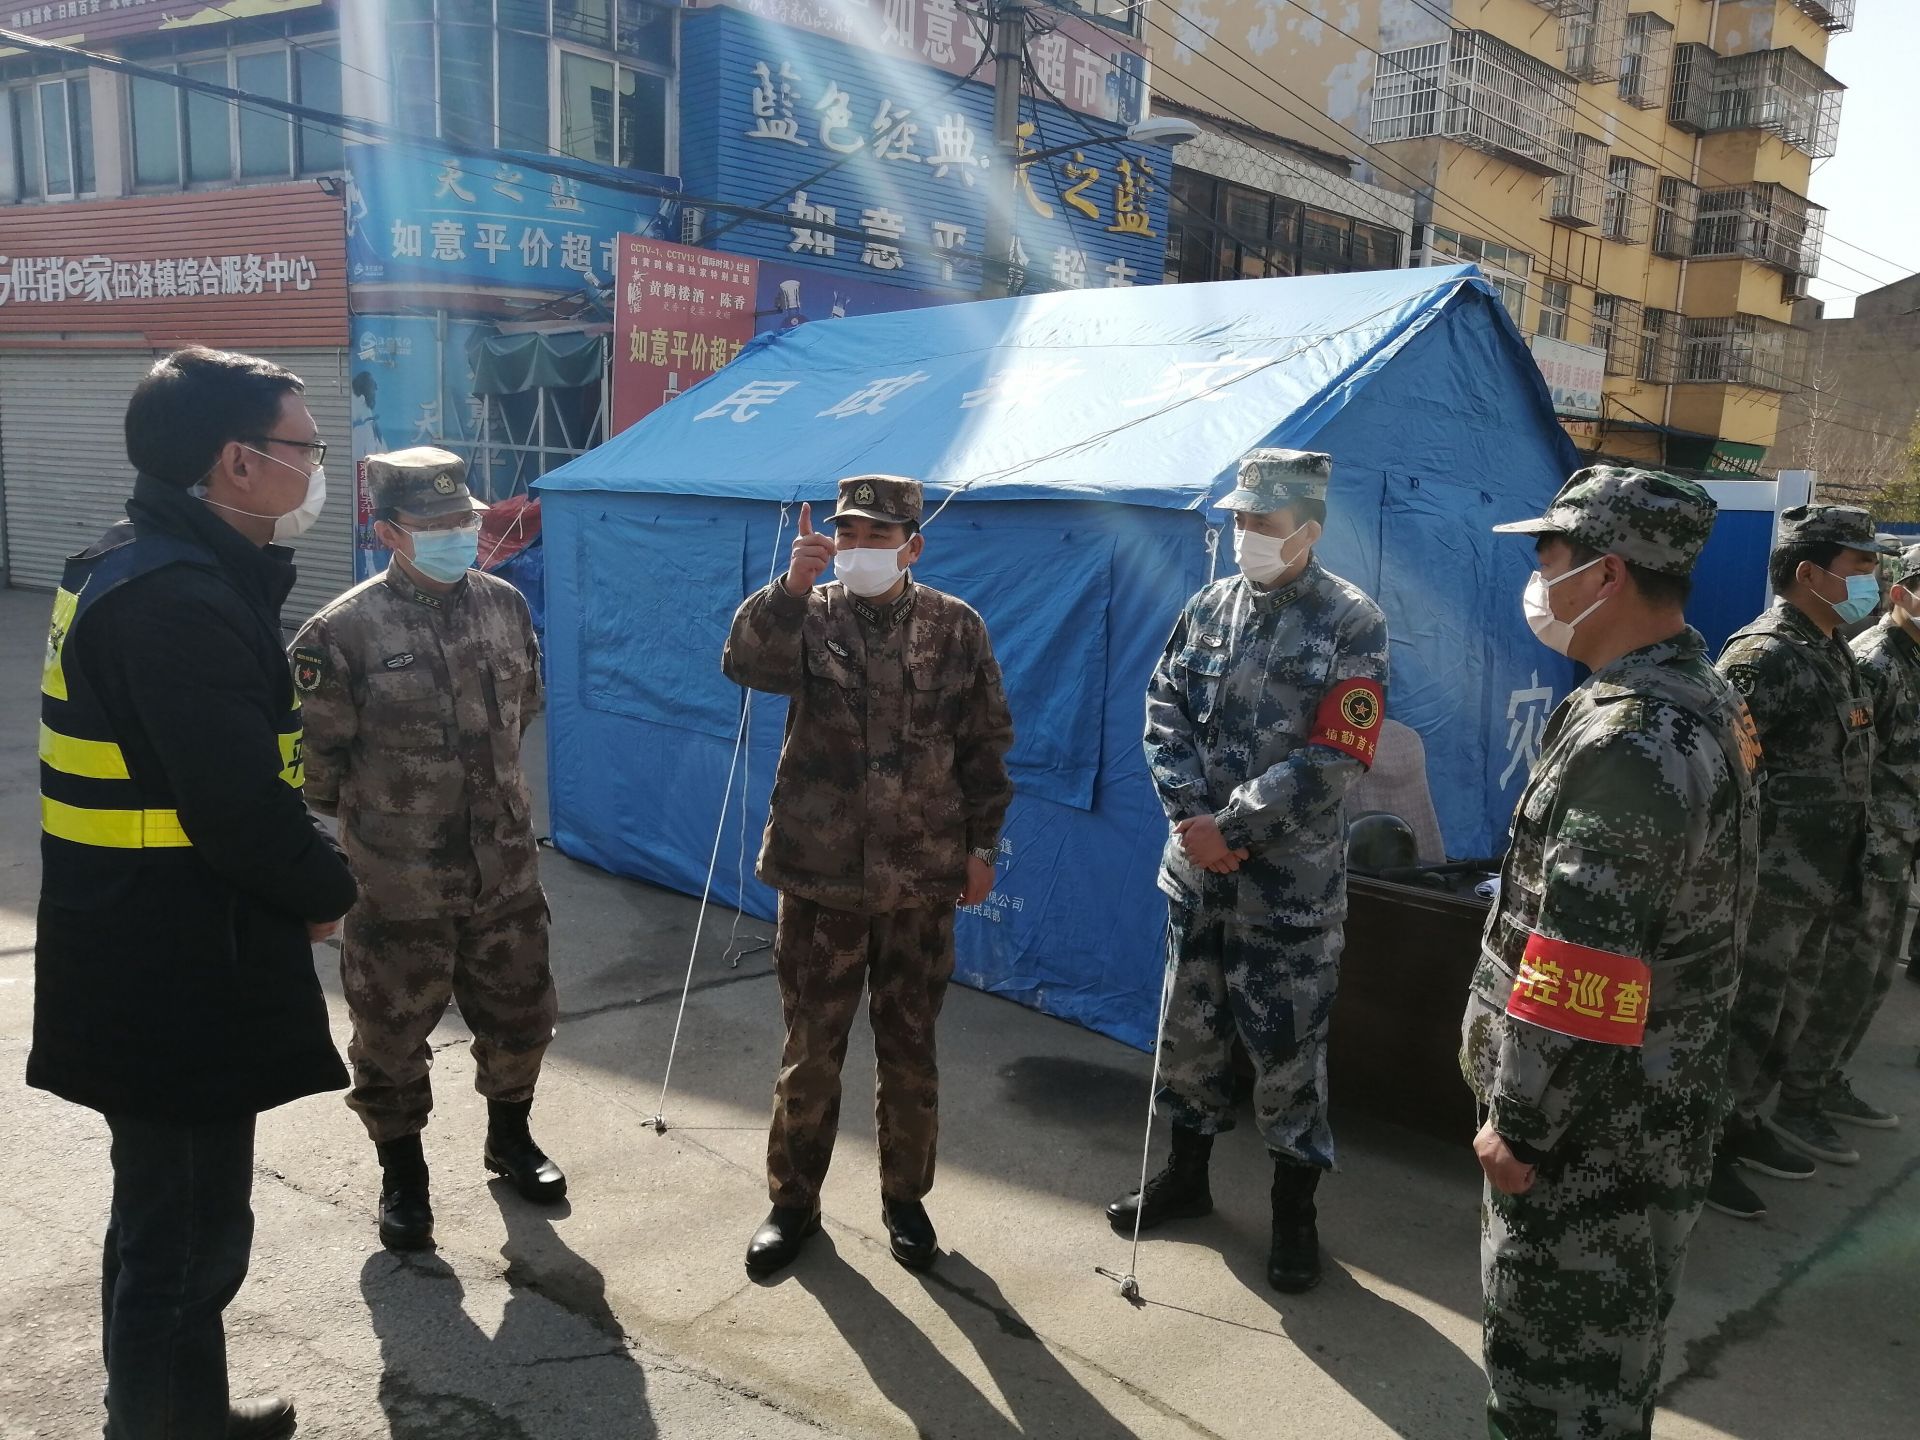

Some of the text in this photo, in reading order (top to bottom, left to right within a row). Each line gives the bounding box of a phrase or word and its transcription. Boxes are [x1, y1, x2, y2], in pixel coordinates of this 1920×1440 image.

[880, 0, 1101, 108] 如意平超市
[956, 901, 1001, 923] 国民政部
[986, 891, 1025, 912] 限公司
[1514, 956, 1644, 1024] 控巡查
